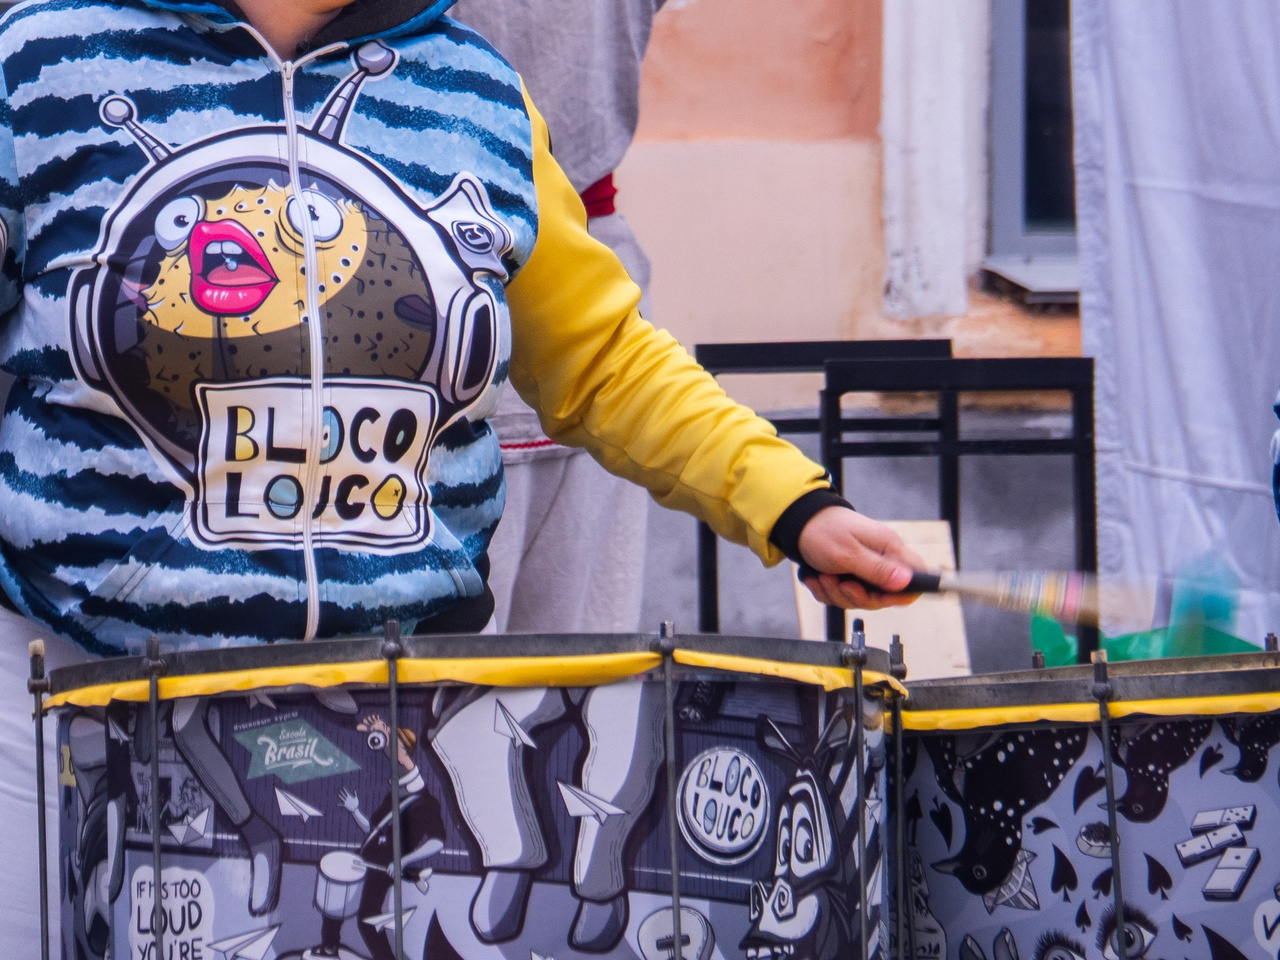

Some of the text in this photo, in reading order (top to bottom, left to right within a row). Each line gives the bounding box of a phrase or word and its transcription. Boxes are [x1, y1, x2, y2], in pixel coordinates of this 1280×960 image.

[257, 736, 333, 767] Brasil
[696, 755, 761, 810] BLOCO
[692, 791, 754, 842] LOUCO
[170, 878, 201, 899] TOO
[137, 900, 202, 936] LOUD
